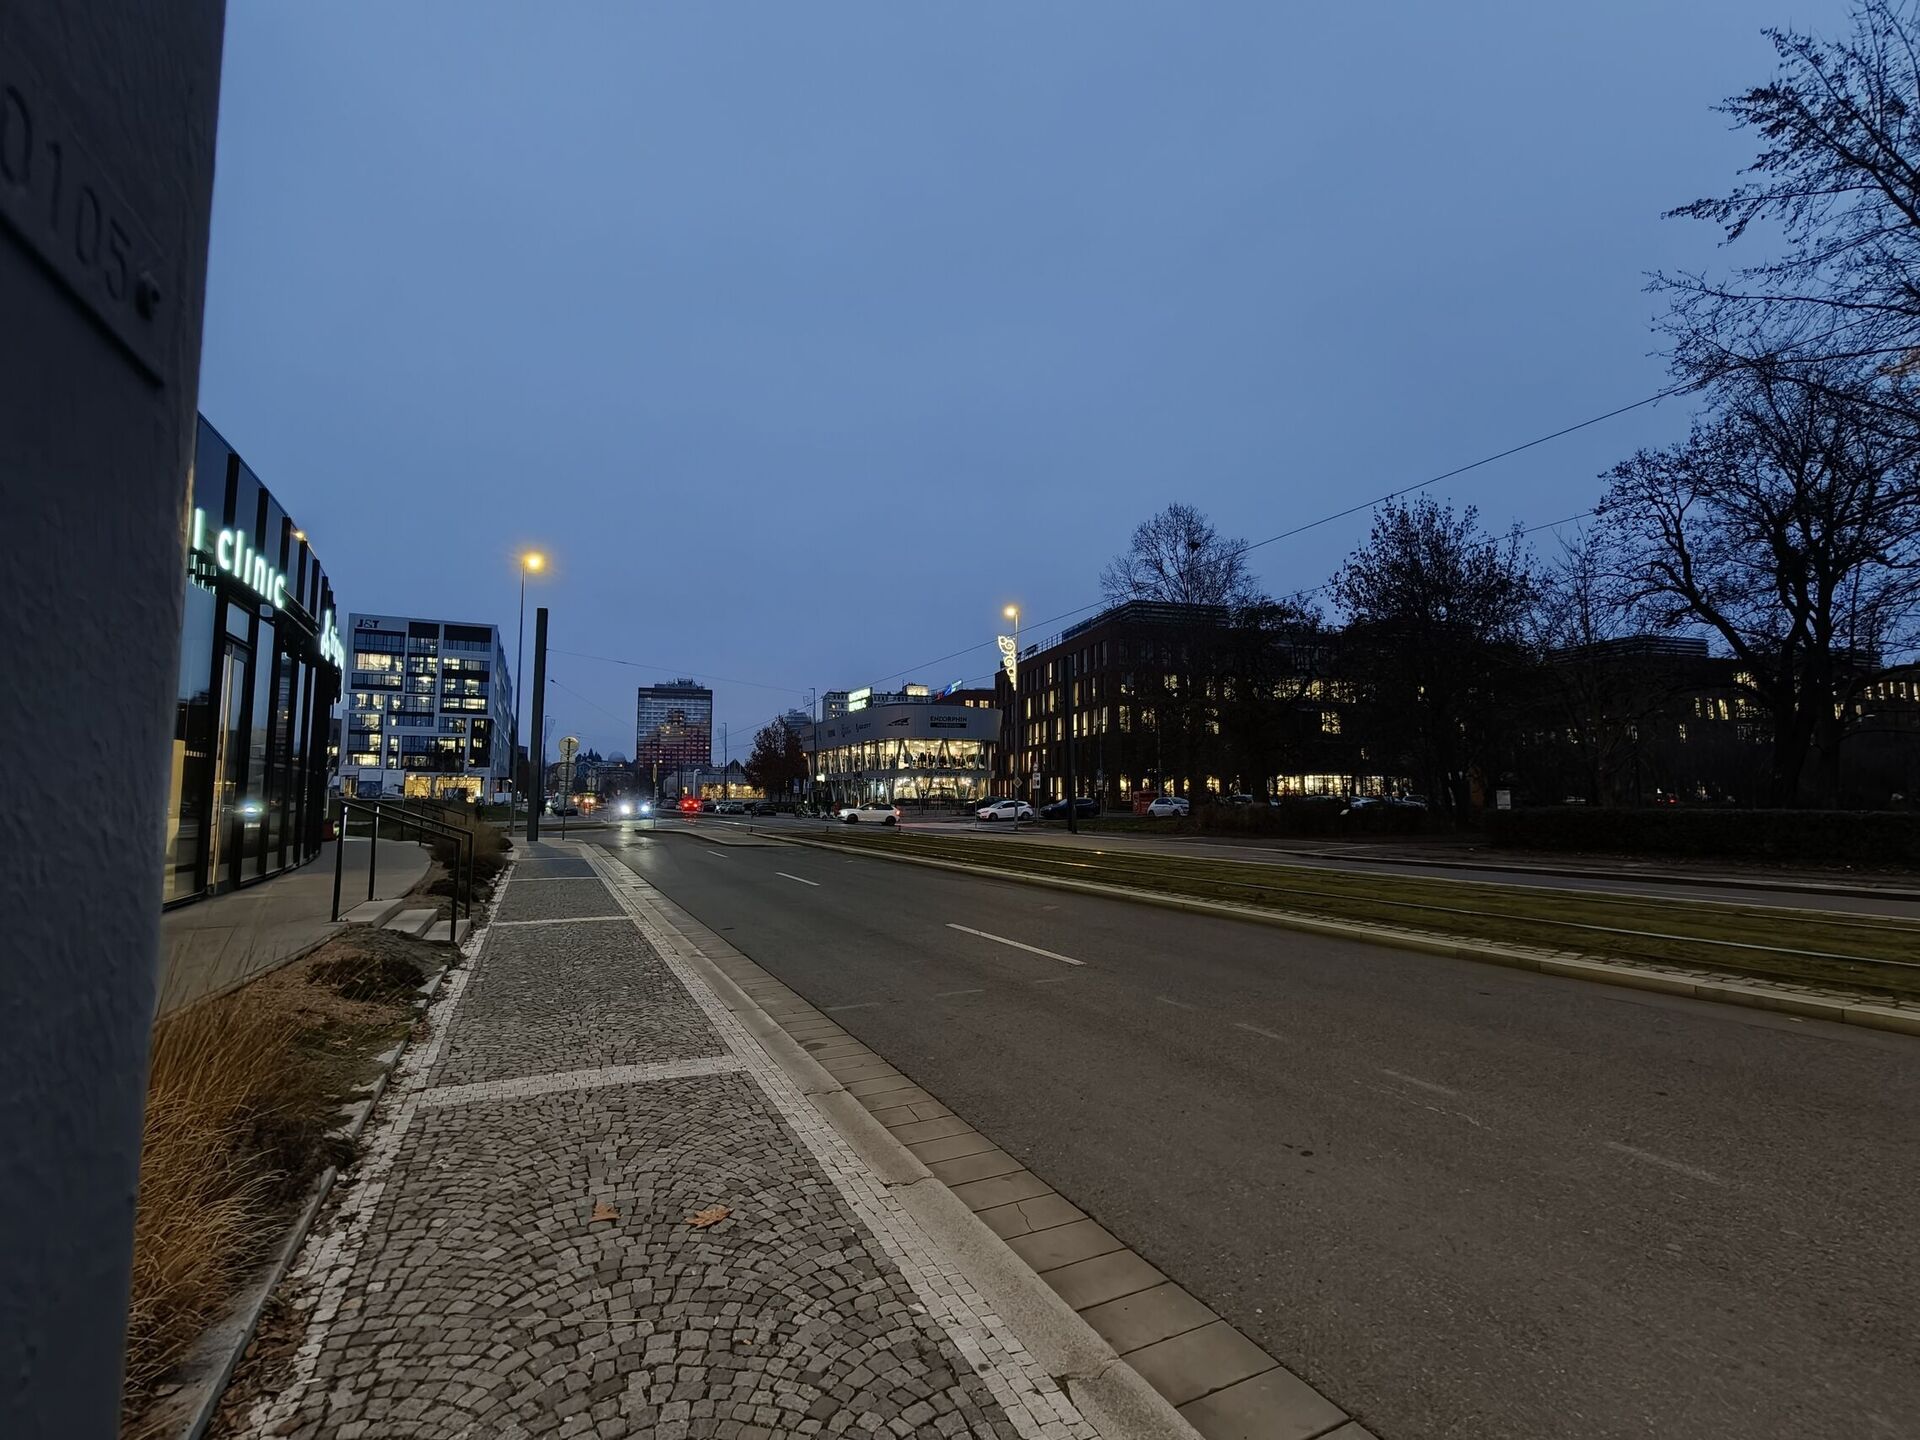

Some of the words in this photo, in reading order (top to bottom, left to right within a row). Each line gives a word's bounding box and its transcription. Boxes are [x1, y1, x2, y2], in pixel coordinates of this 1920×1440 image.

[0, 85, 132, 301] 0105
[217, 528, 287, 609] clinic
[357, 618, 380, 629] J&T
